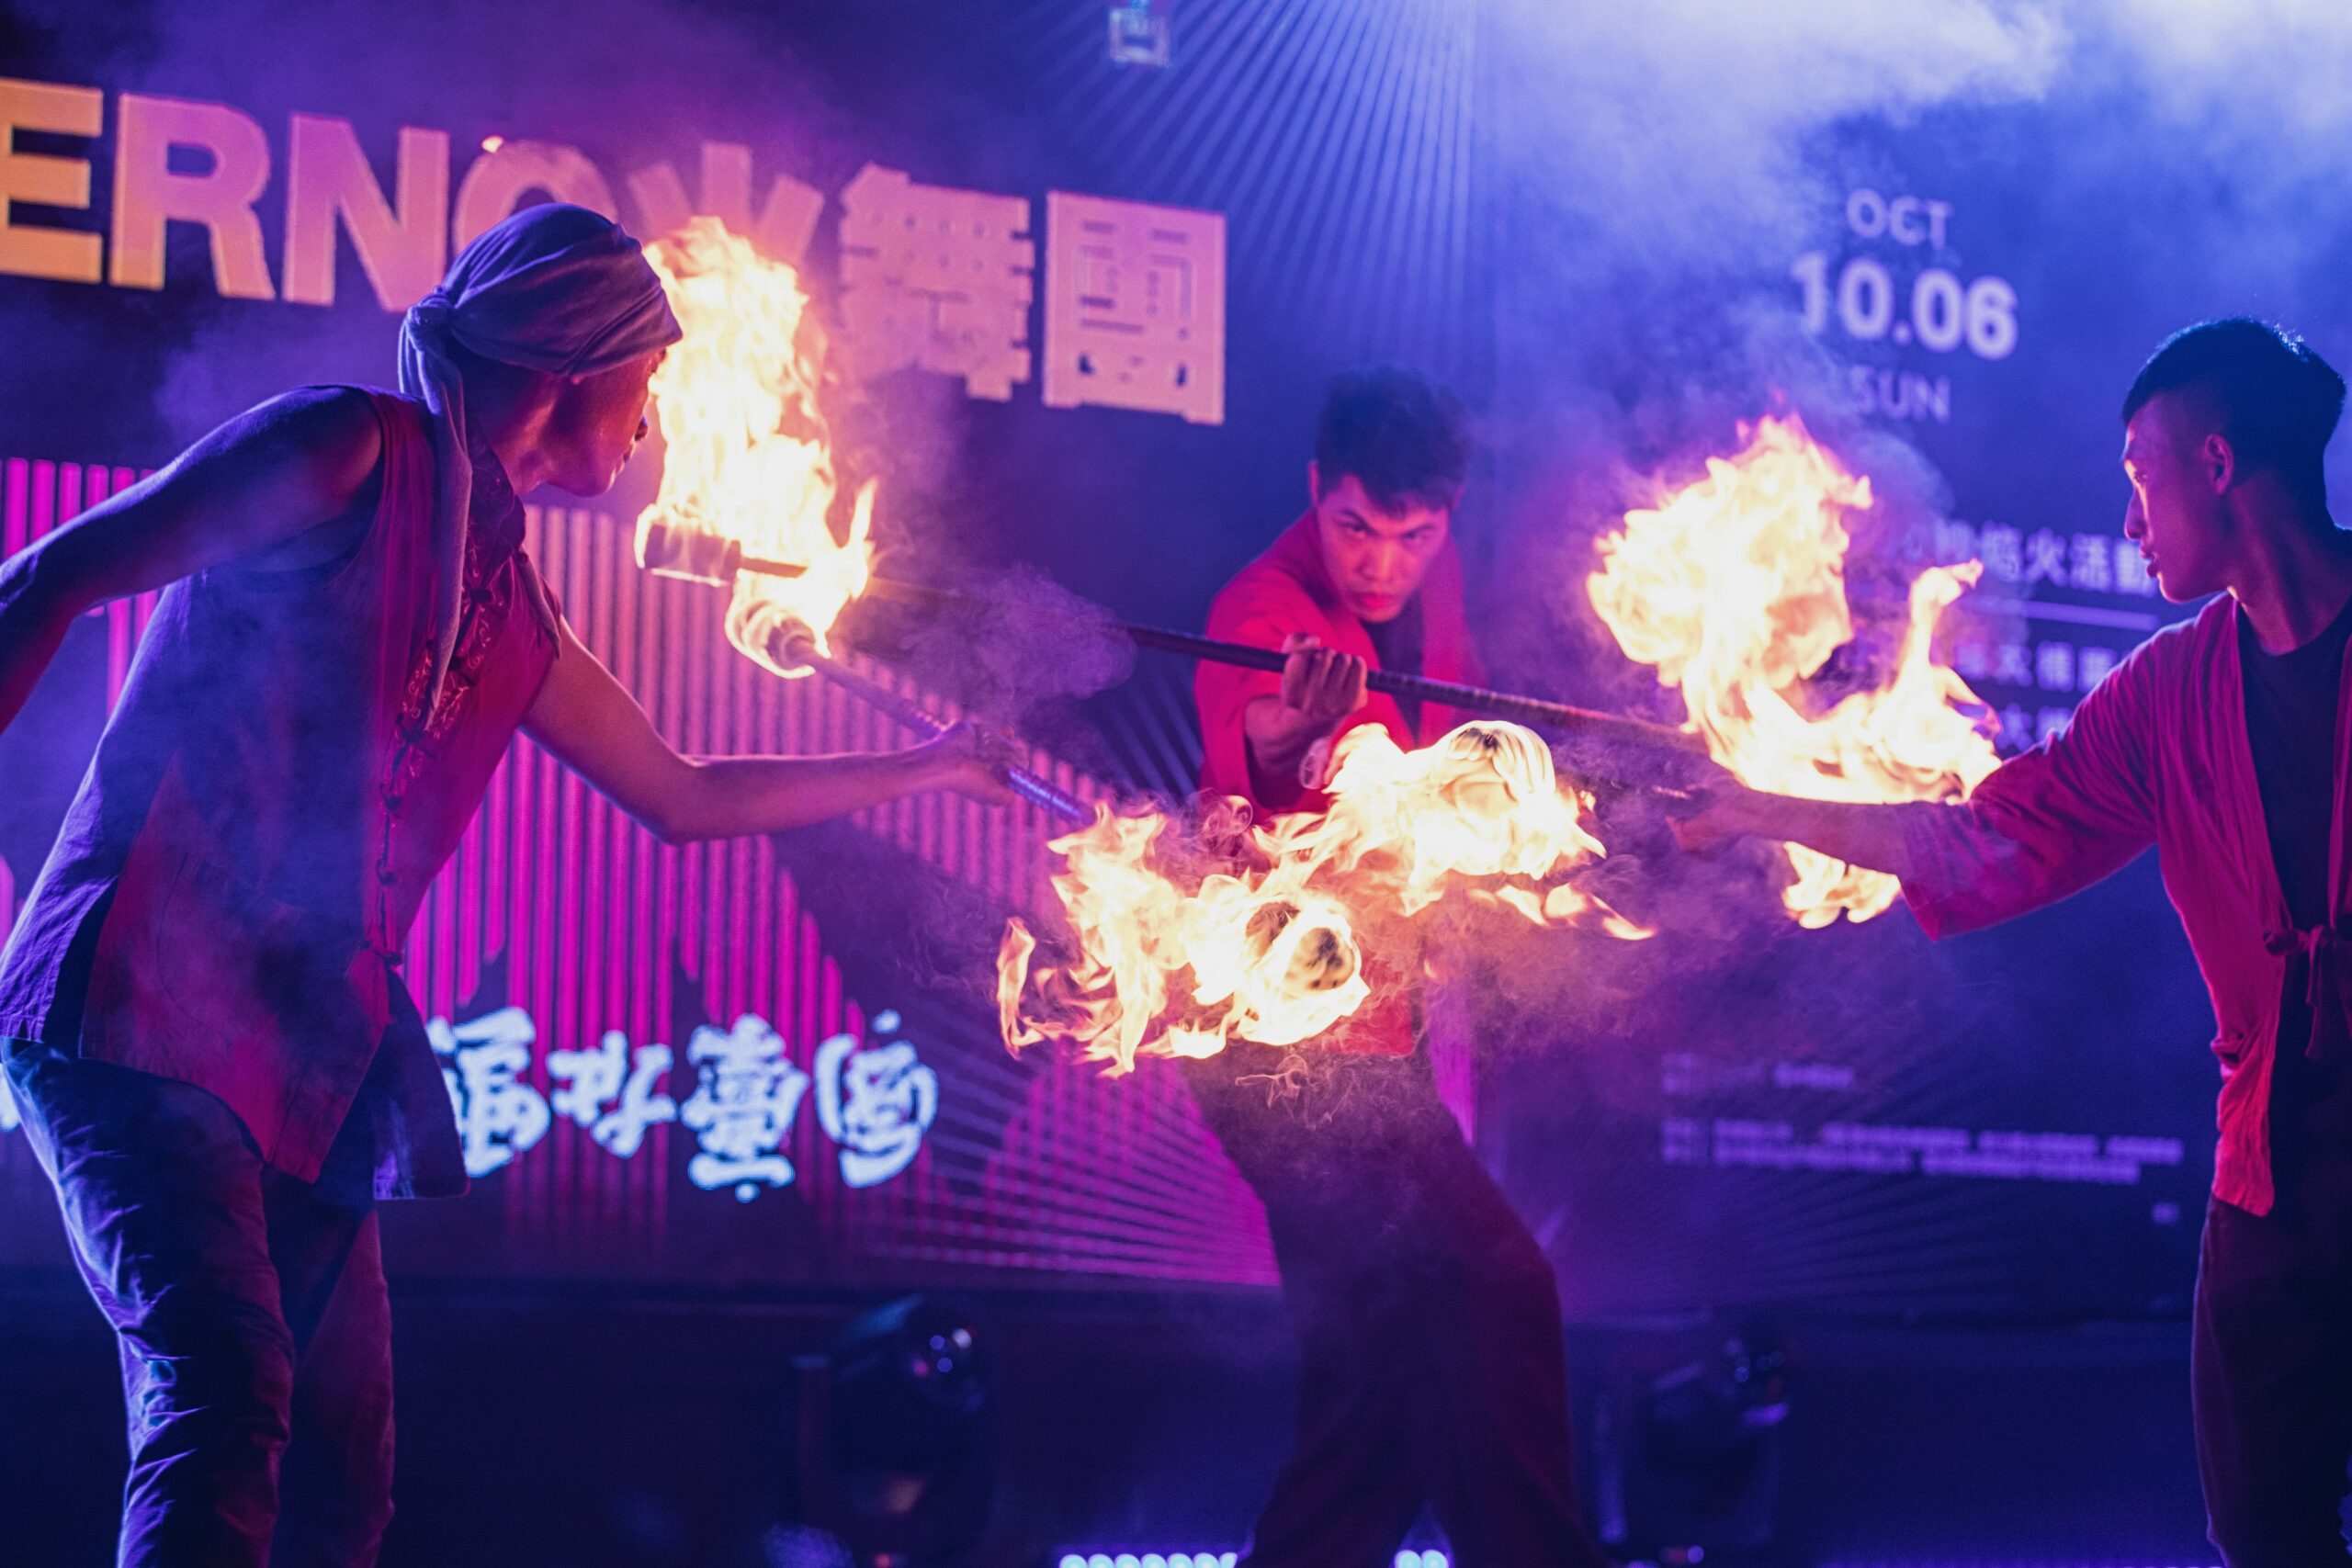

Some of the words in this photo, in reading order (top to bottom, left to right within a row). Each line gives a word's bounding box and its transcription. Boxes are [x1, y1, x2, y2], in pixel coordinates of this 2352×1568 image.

[1846, 187, 1955, 251] OCT
[1792, 250, 2018, 360] 10.06
[1848, 364, 1951, 425] SUN
